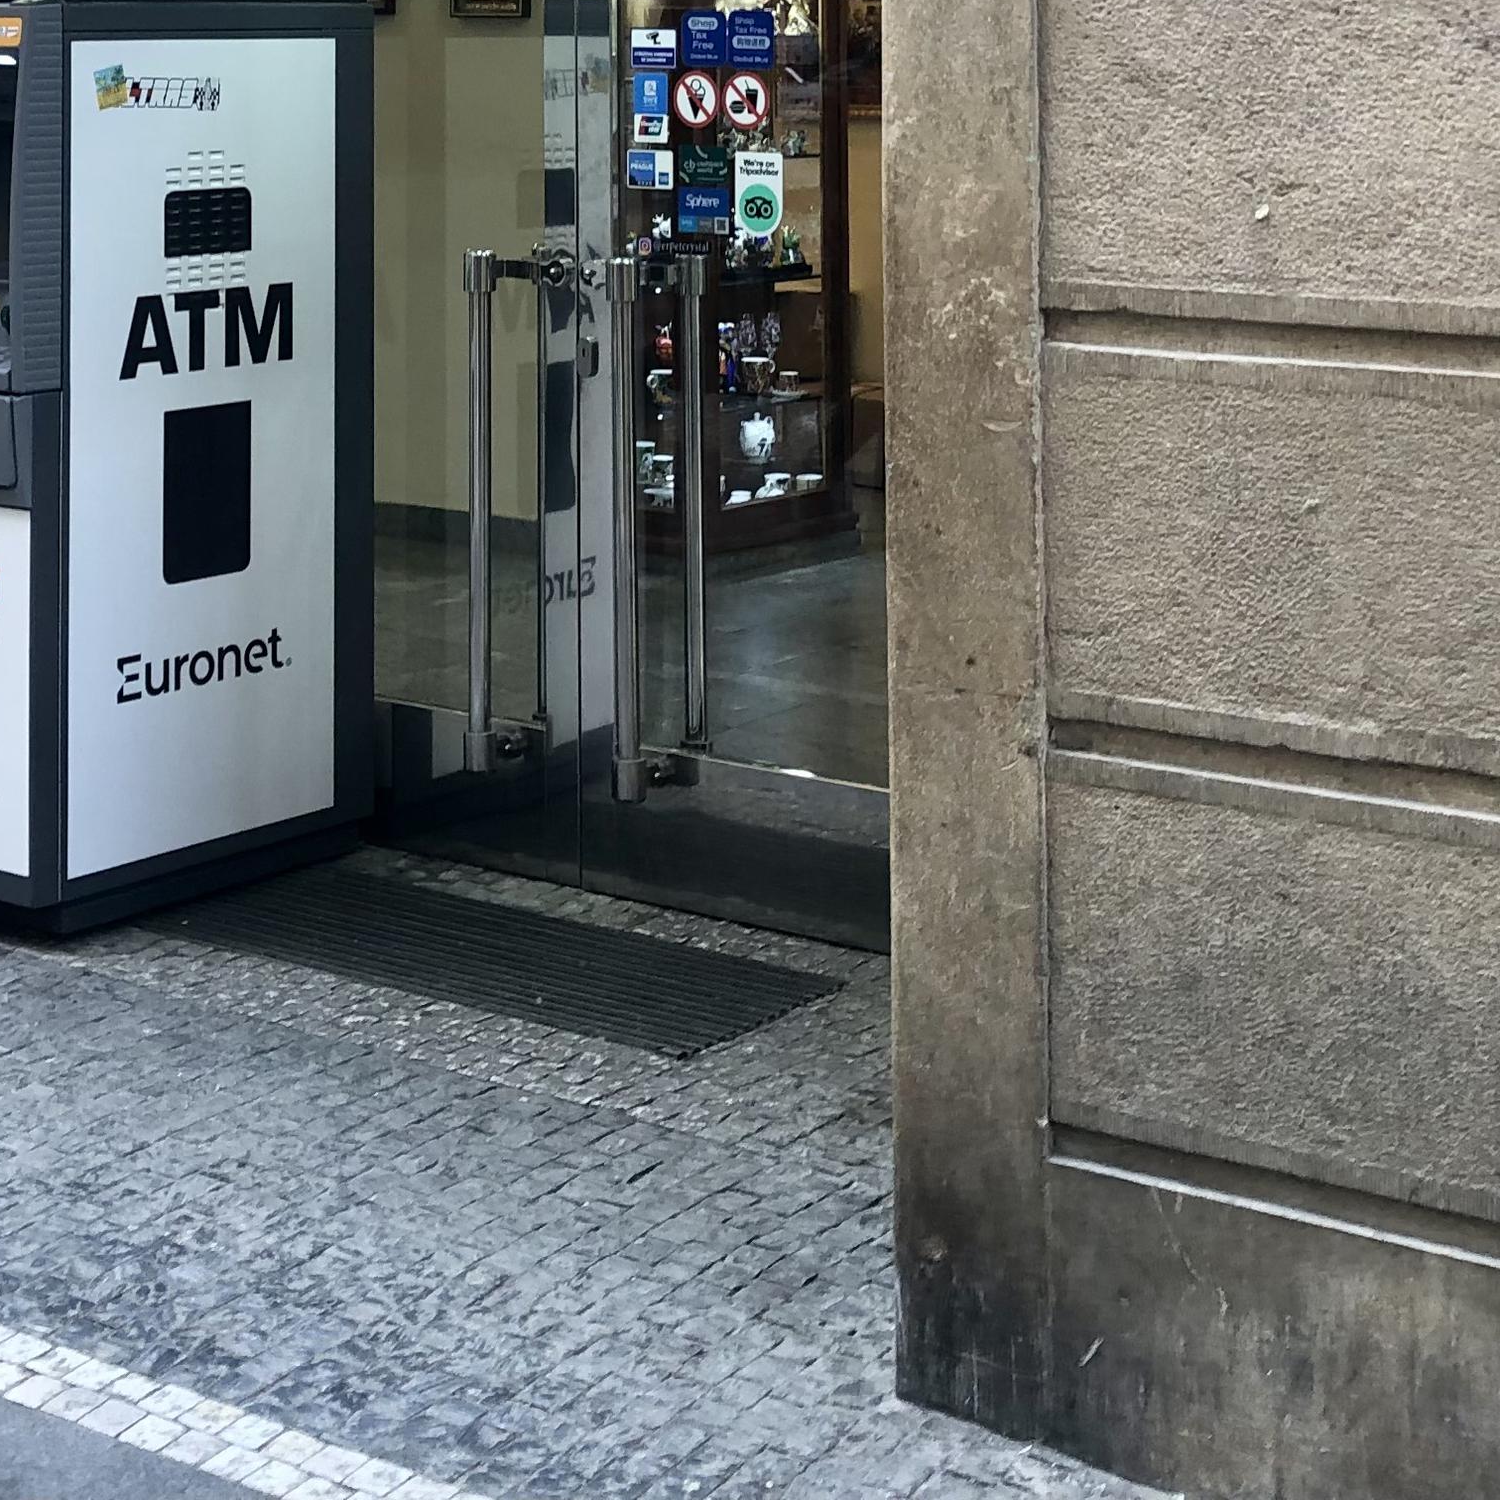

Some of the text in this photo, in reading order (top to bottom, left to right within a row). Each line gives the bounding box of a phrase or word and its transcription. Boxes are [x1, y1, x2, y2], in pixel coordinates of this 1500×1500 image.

[743, 158, 764, 168] We're
[685, 194, 720, 209] Sphere
[119, 282, 294, 381] ATM
